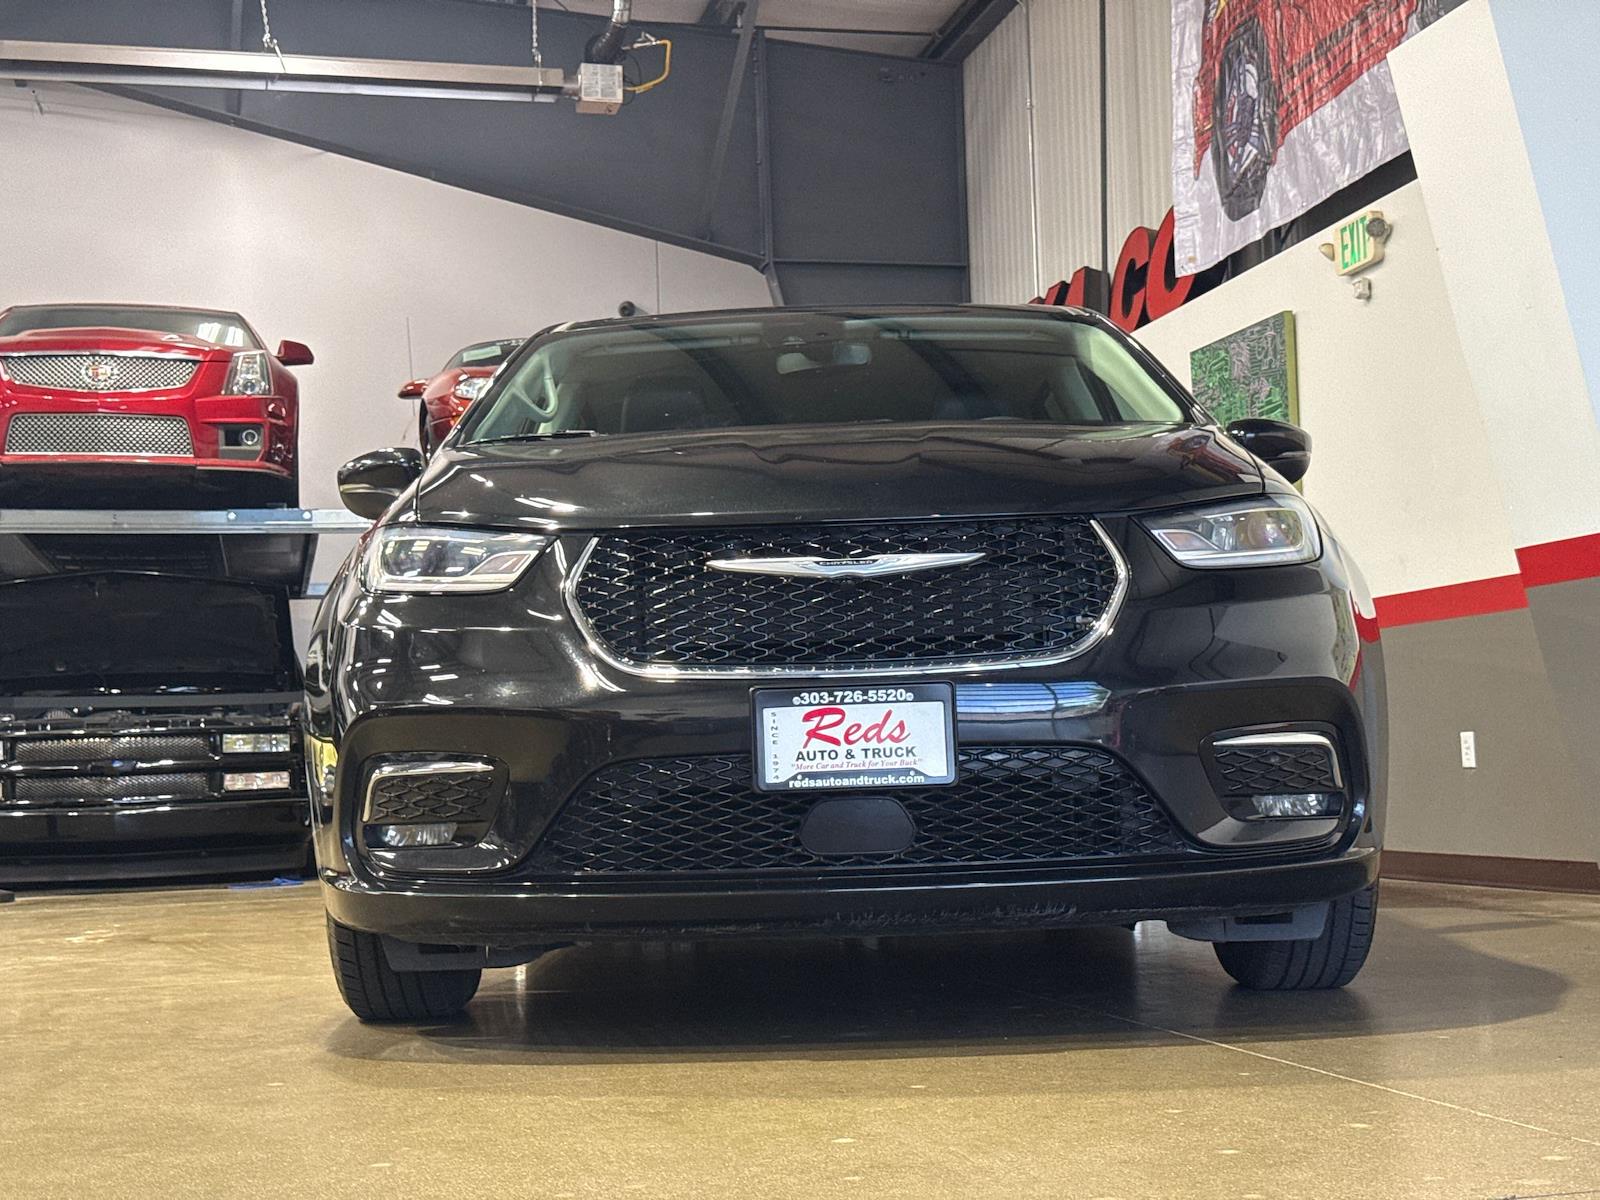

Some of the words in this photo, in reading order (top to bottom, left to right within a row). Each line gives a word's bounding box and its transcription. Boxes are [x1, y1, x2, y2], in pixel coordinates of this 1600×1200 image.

[1340, 215, 1368, 269] EXIT
[799, 688, 906, 705] 303-726-5520
[802, 707, 911, 750] Reds
[795, 749, 839, 762] AUTO
[844, 748, 856, 760] &
[860, 745, 917, 759] TRUCK
[815, 762, 829, 770] Car
[830, 760, 844, 769] and
[845, 760, 866, 769] Truck
[867, 759, 878, 769] for
[880, 759, 898, 767] Your
[789, 774, 925, 788] redsautoandtruck.com
